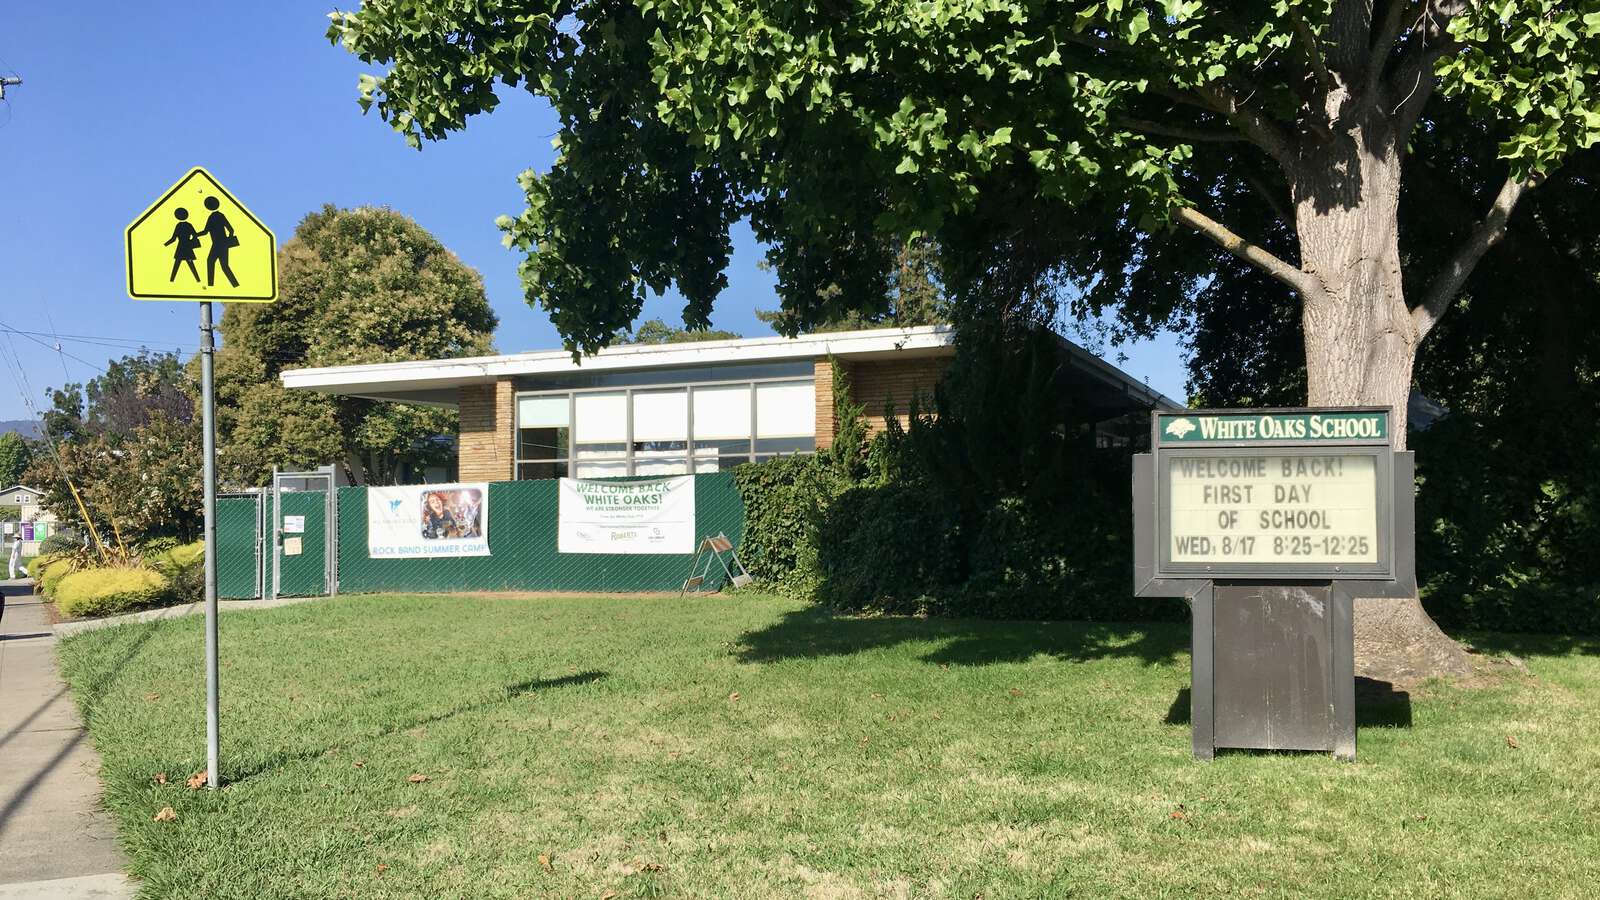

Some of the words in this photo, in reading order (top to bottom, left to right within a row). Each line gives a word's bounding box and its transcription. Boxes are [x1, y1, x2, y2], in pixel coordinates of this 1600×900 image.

[1199, 417, 1256, 439] WHITE
[1259, 416, 1306, 438] OAKS
[1310, 415, 1380, 438] SCHOOL
[1181, 458, 1267, 478] WELCOME
[1282, 457, 1344, 477] BACK!
[576, 483, 634, 494] WELCOME
[639, 482, 671, 493] BACK
[1203, 485, 1253, 504] FIRST
[1274, 484, 1312, 503] DAY
[584, 494, 620, 504] WHITE
[623, 494, 663, 504] OAKS!
[1218, 510, 1238, 529] OF
[1259, 510, 1331, 529] SCHOOL
[373, 546, 396, 554] ROCK
[398, 546, 420, 554] BAND
[423, 545, 459, 553] SUMMER
[462, 544, 486, 552] CAMP
[1222, 536, 1256, 555] 8/17
[1273, 536, 1369, 555] 8:25-12:25
